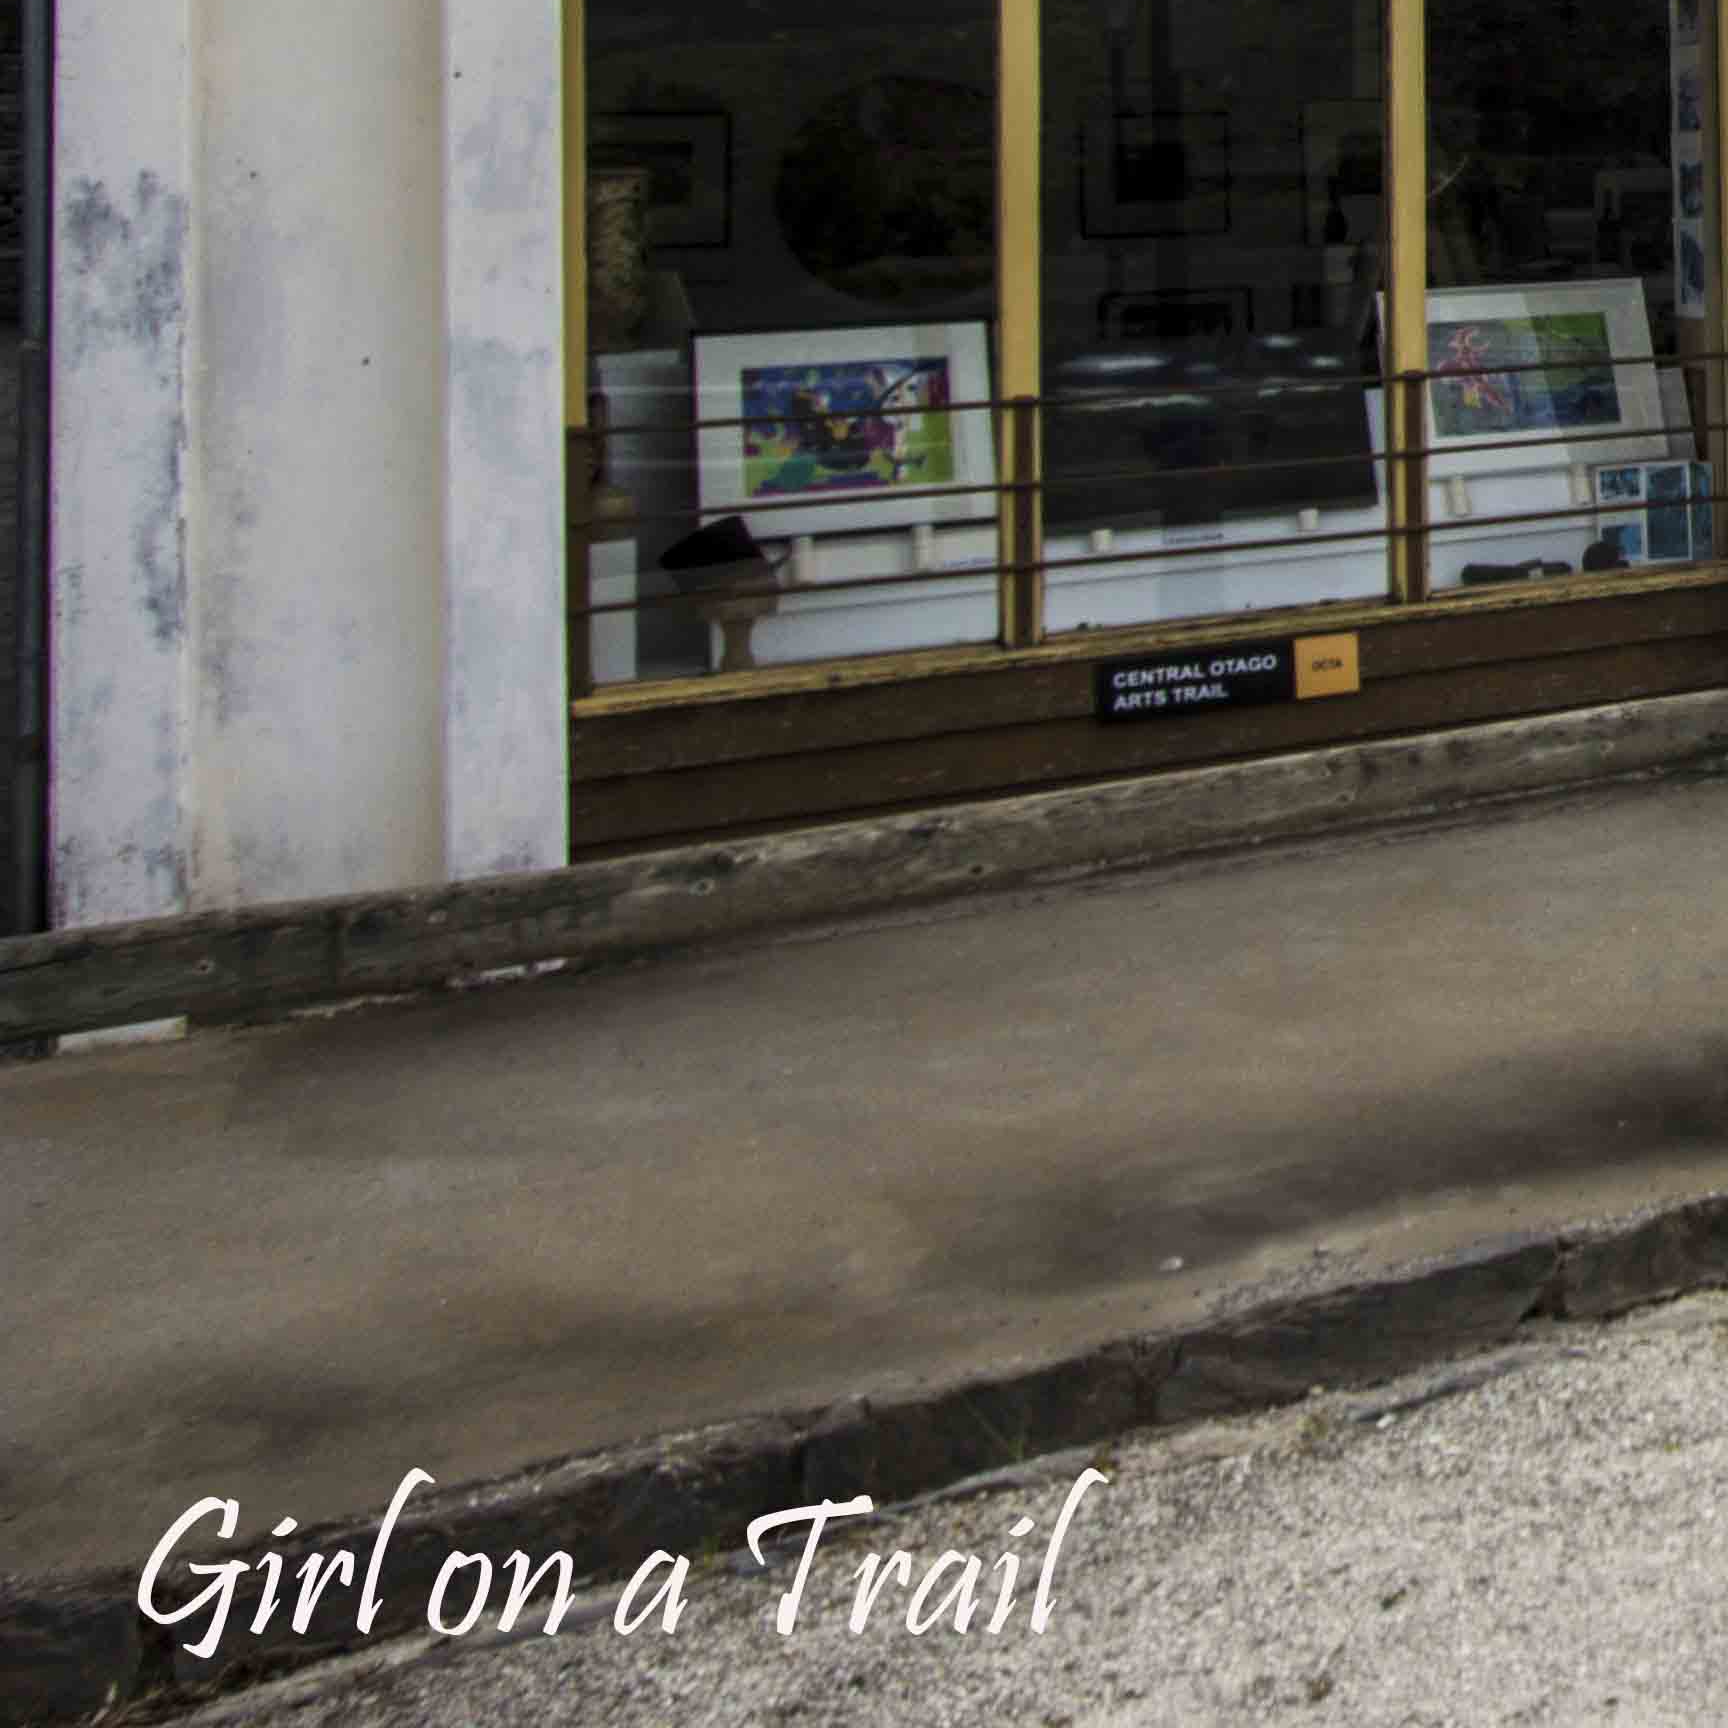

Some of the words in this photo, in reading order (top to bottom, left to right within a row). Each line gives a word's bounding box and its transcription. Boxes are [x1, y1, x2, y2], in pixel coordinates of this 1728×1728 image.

[1113, 661, 1205, 689] CENTRAL
[1210, 654, 1278, 676] OTAGO
[1113, 689, 1167, 711] ARTS
[1171, 683, 1229, 703] TRAIL
